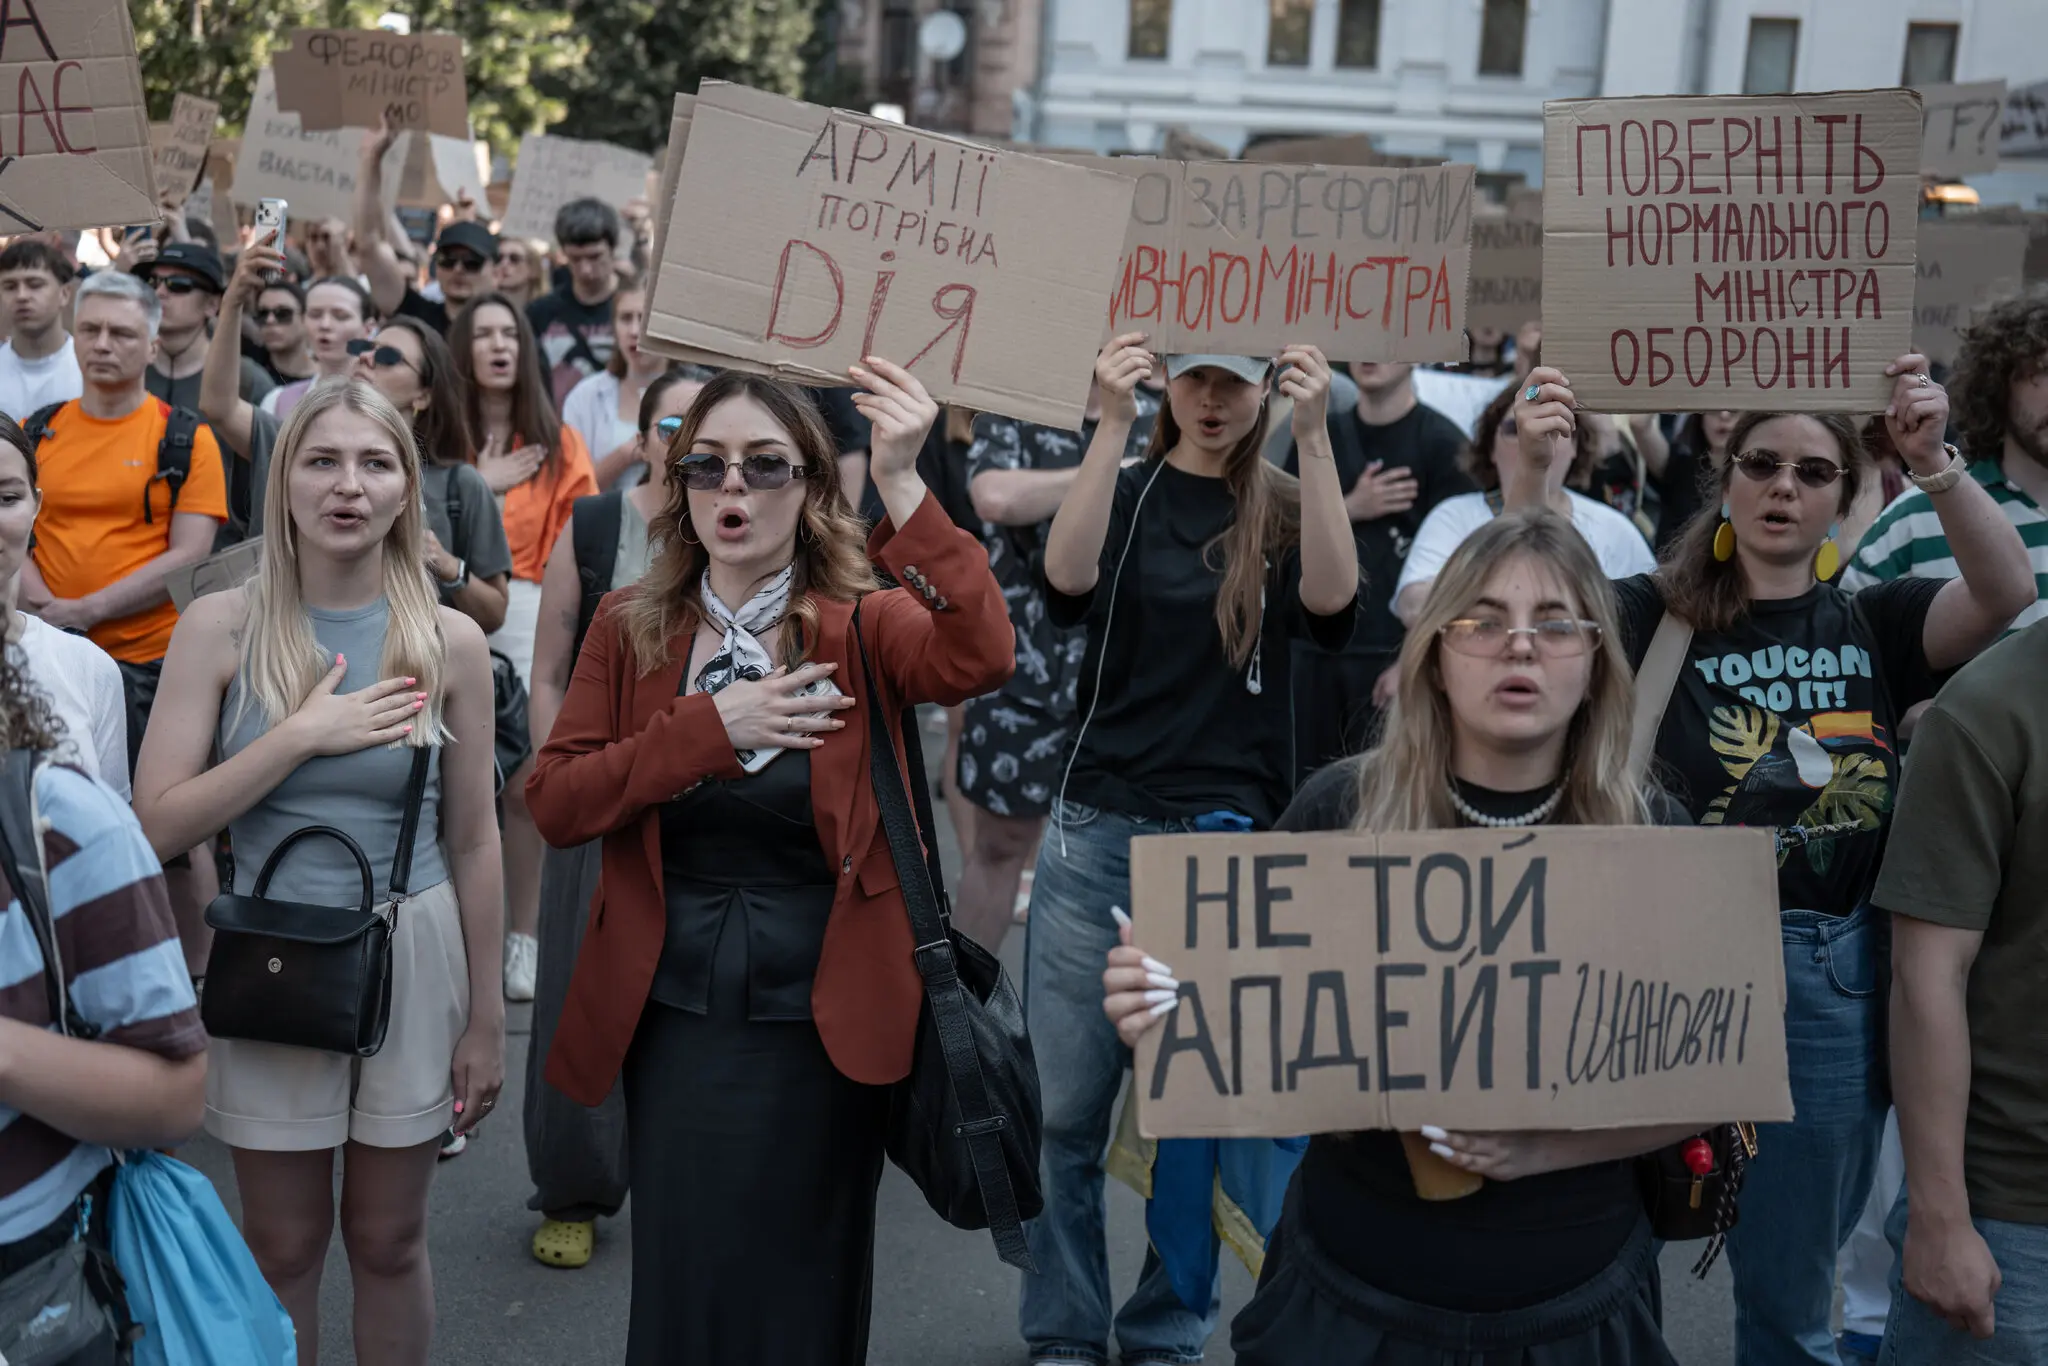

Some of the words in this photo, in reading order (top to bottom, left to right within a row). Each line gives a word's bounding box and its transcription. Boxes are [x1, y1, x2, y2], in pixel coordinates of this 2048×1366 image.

[307, 33, 456, 74] ФЕДОРОВ
[1576, 114, 1885, 197] ПОВЕРНІТЬ
[1605, 200, 1890, 267] НОРМАЛЬНОГО
[1694, 268, 1882, 323] МІНІСТРА
[1610, 326, 1851, 390] ОБОРОНИ
[1694, 644, 1872, 687] TOUCAN
[1738, 681, 1793, 712] DO
[1798, 680, 1847, 710] IT!
[1184, 853, 1311, 950] НЕ
[1348, 832, 1548, 956] ТОЙ
